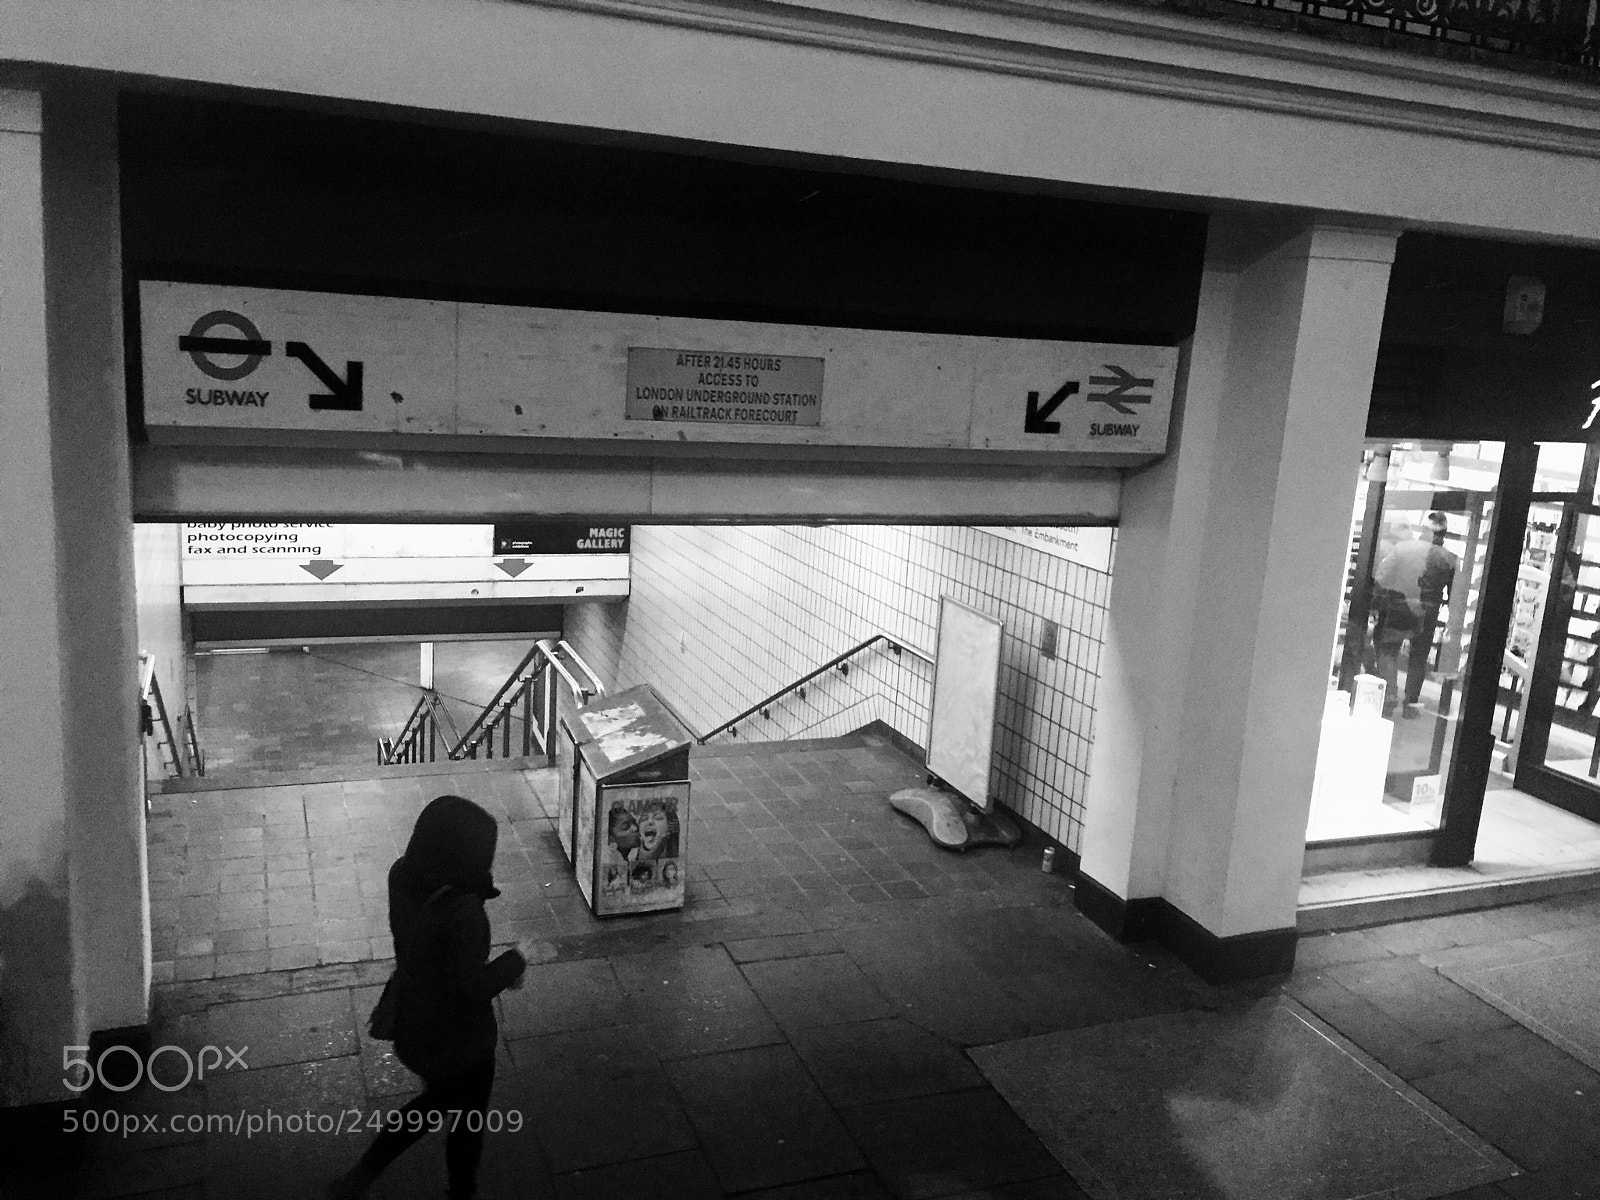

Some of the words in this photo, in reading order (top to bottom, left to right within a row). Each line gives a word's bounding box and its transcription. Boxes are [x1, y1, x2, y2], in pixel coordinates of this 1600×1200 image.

[676, 353, 711, 368] AFTER
[713, 355, 740, 370] 21.45
[743, 357, 781, 372] HOURS
[698, 372, 742, 387] ACCESS
[745, 374, 759, 388] TO
[185, 387, 270, 407] SUBWAY
[635, 386, 684, 401] LONDON
[686, 388, 770, 405] UNDERGROUND
[772, 392, 817, 407] STATION
[671, 405, 732, 420] RAILTRACK
[734, 407, 798, 423] FORECOURT
[1089, 423, 1140, 437] SUBWAY
[187, 532, 298, 543] photocopying
[589, 527, 625, 538] MAGIC
[1034, 529, 1079, 552] Embankment
[188, 545, 212, 554] fax
[217, 545, 247, 554] and
[252, 545, 321, 556] scanning
[576, 538, 624, 549] GALLERY
